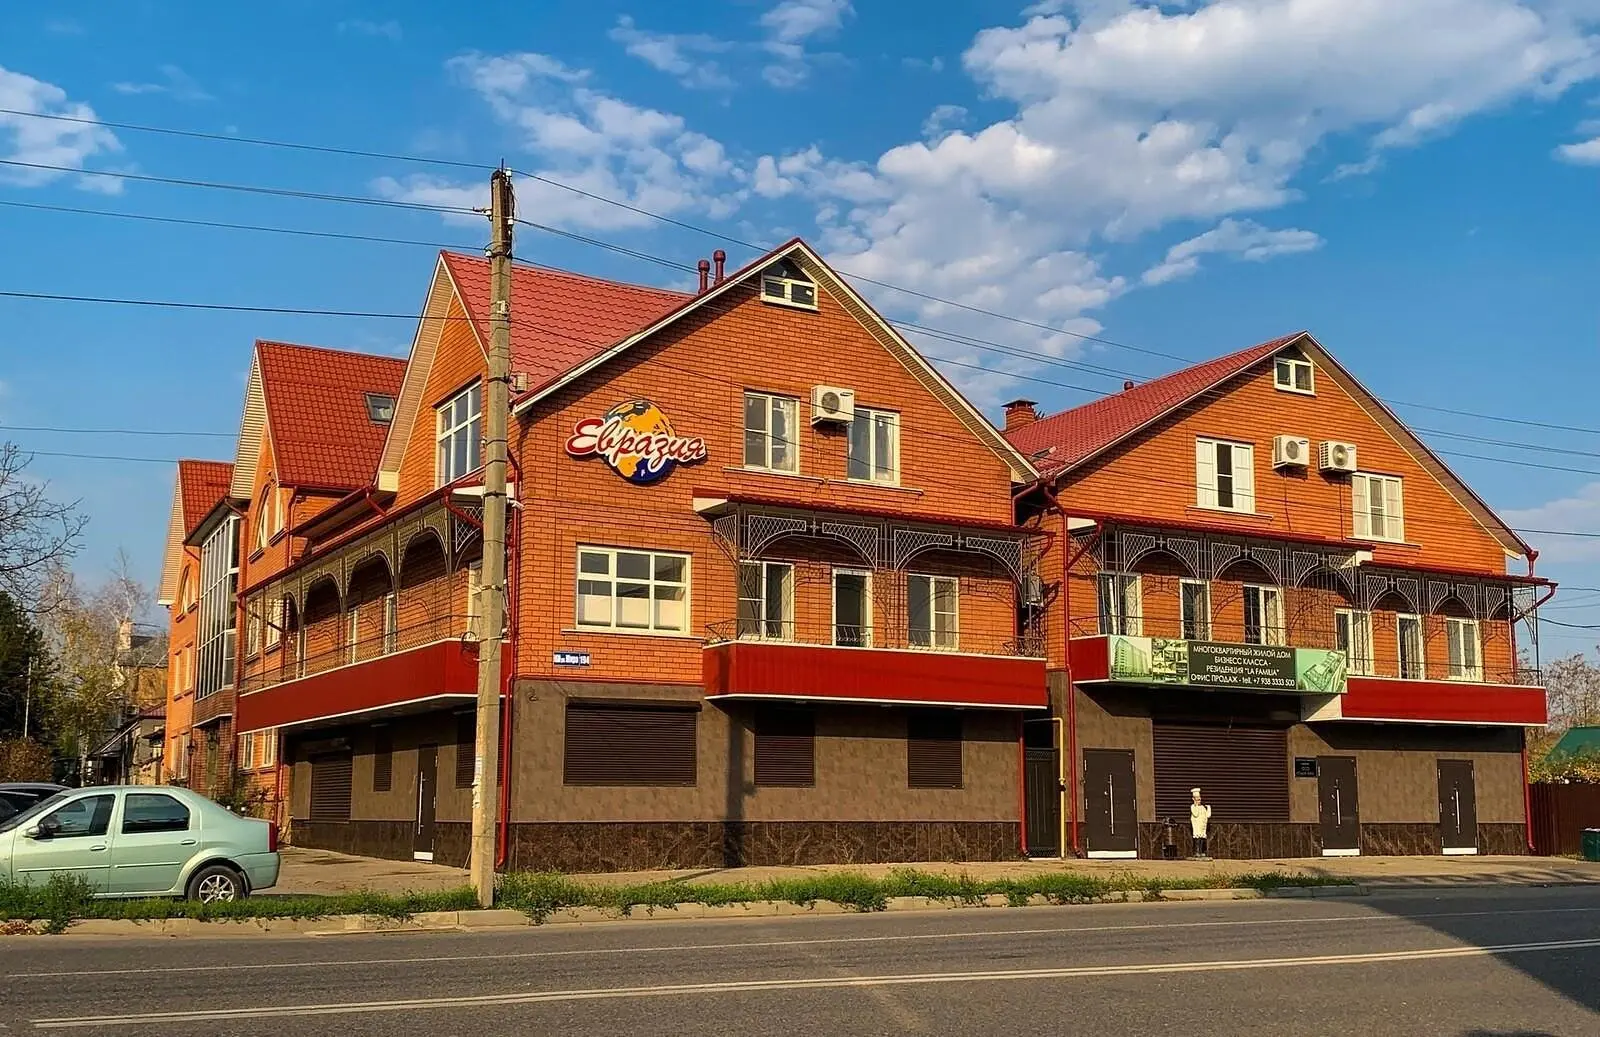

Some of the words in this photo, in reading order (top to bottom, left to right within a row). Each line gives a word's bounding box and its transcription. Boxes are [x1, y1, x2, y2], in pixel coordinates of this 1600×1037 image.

[565, 415, 706, 473] Евразия
[1193, 646, 1252, 656] МНОГОКВАРТИРНЫЙ
[1253, 649, 1276, 658] ЖИЛОЙ
[1276, 651, 1292, 659] ДОМ
[1243, 657, 1269, 667] КЛАССА
[1206, 665, 1244, 674] РЕЗИДЕНЦИЯ
[1190, 673, 1211, 682] ОФИС
[1211, 675, 1238, 683] ПРОДАЖ
